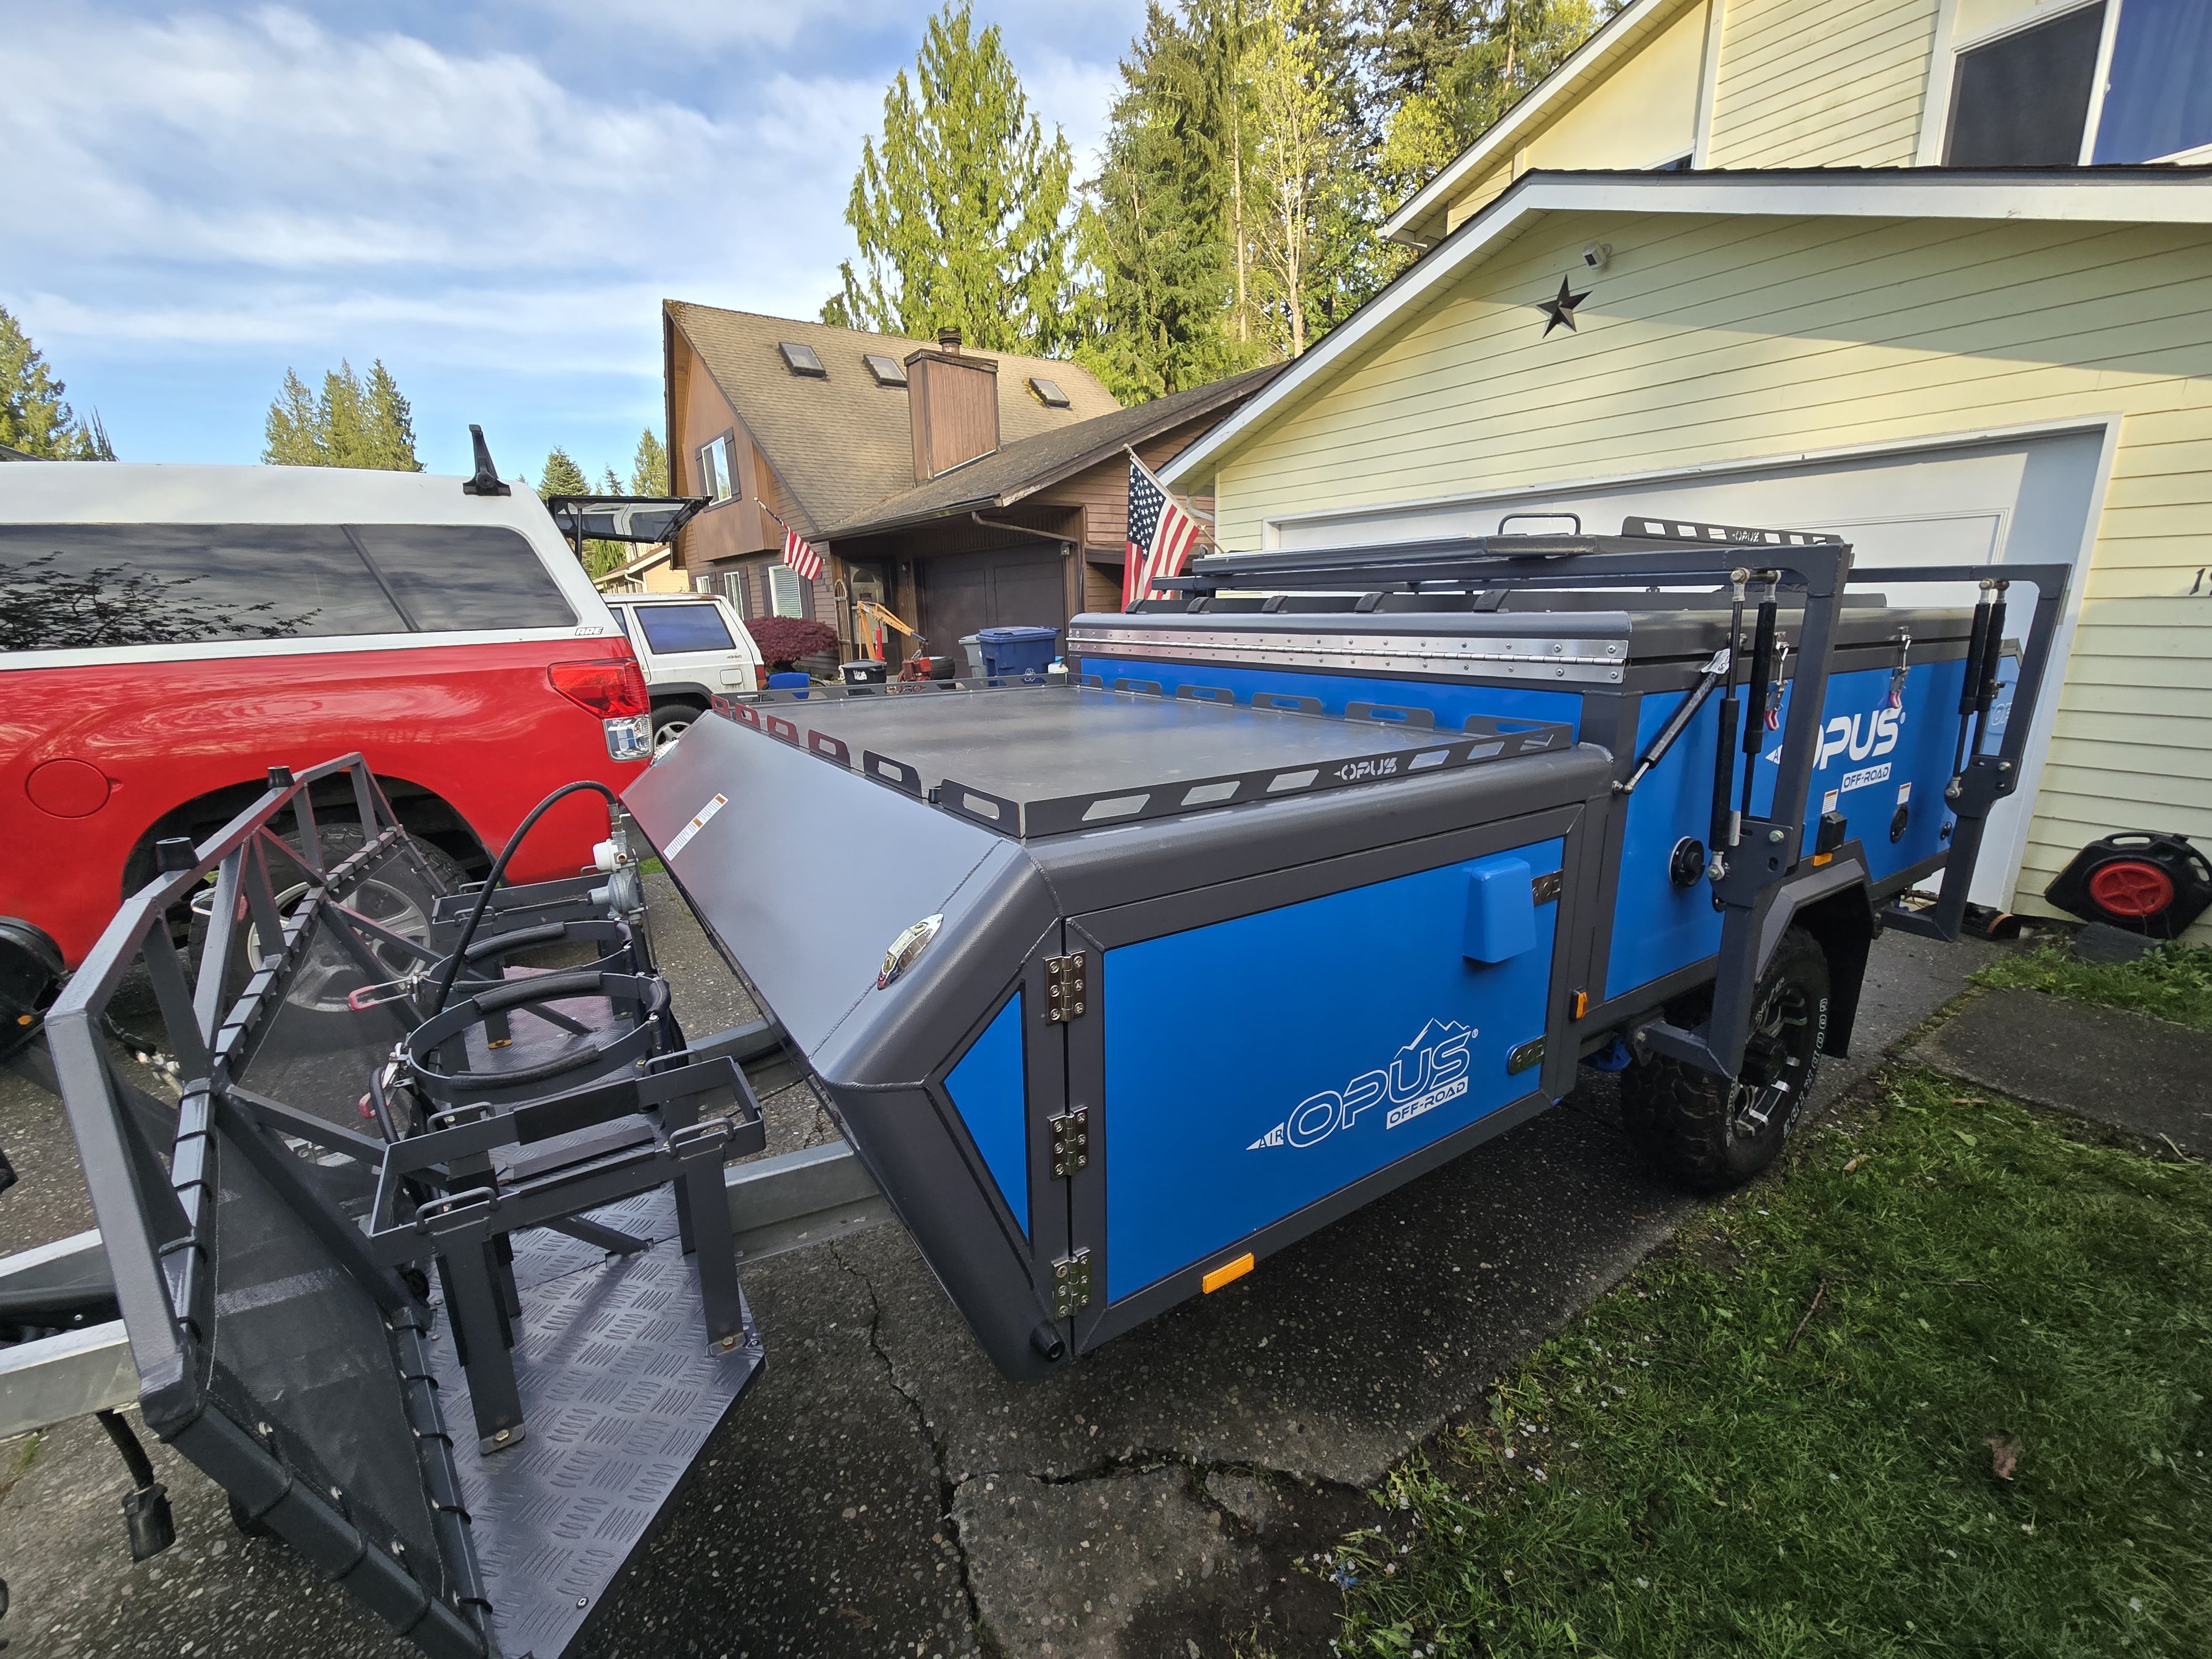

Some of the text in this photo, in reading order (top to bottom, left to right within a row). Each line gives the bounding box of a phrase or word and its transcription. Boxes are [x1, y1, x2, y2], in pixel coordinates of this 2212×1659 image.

[1735, 531, 1759, 542] OPUS
[2189, 568, 2212, 595] 1
[1341, 757, 1397, 780] OPUS
[1843, 766, 1889, 789] OFF-ROAD
[1287, 1030, 1472, 1147] OPUS
[1389, 1081, 1466, 1125] OFF-ROAD
